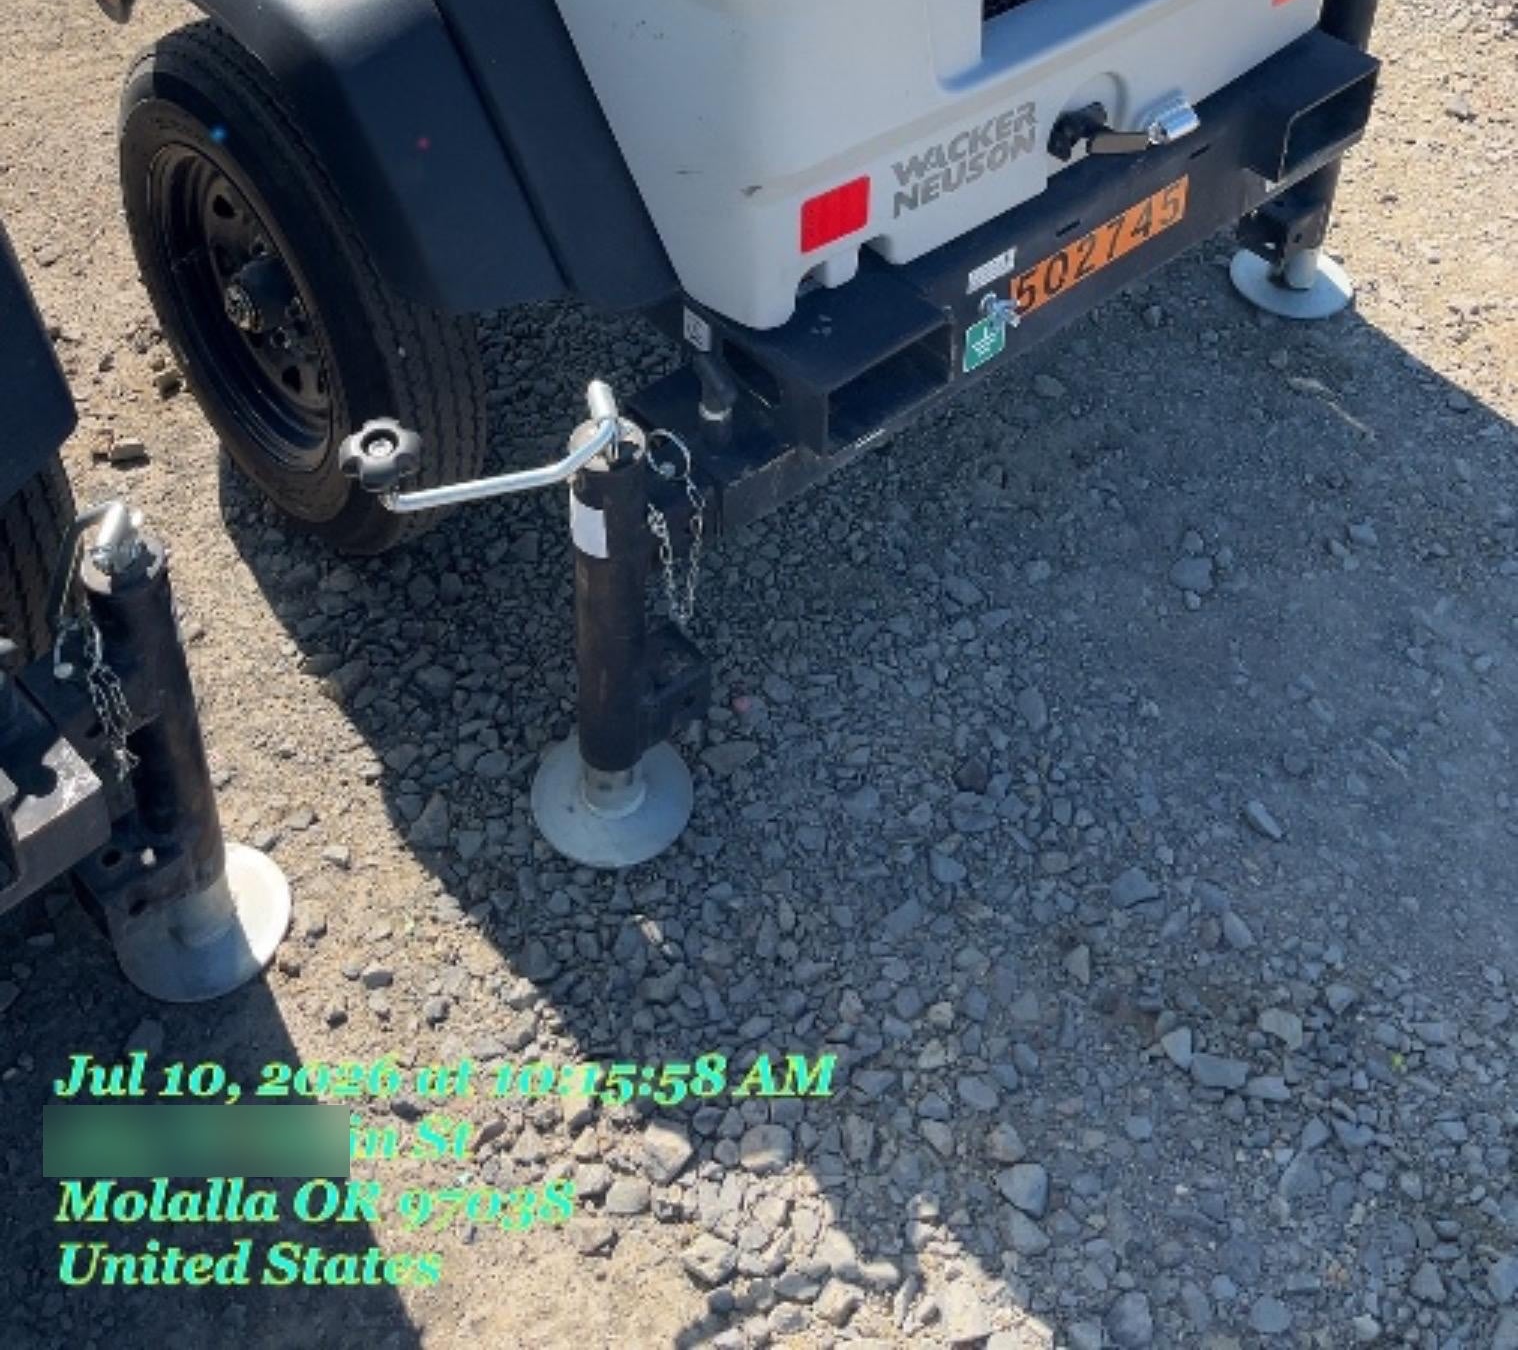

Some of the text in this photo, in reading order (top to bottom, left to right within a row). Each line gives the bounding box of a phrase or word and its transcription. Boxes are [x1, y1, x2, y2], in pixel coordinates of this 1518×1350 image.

[890, 101, 1038, 186] WACKER
[893, 125, 1036, 219] NEUSON
[1013, 195, 1180, 315] 502745
